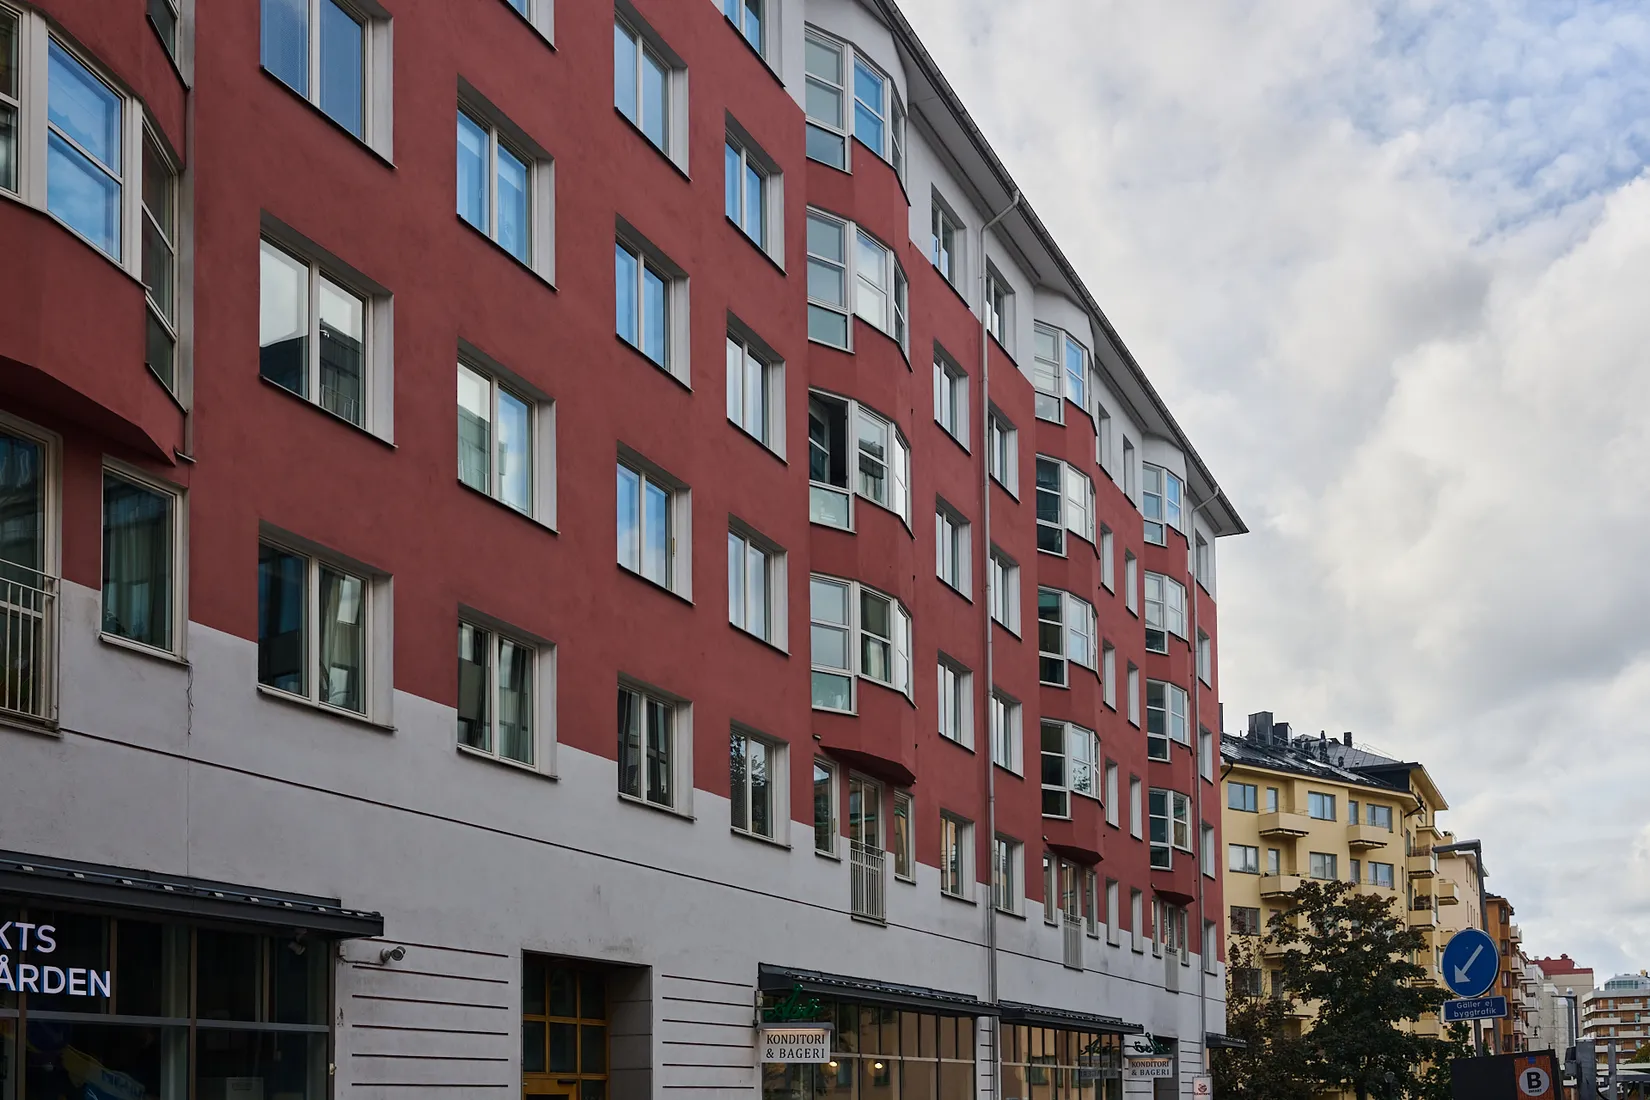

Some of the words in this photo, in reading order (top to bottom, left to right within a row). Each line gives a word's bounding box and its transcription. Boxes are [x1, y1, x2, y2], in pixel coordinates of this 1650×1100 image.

[0, 921, 57, 954] KTS
[0, 954, 111, 998] ÅRDEN
[1456, 1001, 1481, 1009] Gäller
[1485, 999, 1493, 1008] ej
[1453, 1008, 1497, 1018] byggtrafik
[766, 1034, 825, 1045] KONDITORI
[766, 1048, 774, 1059] &
[779, 1048, 825, 1059] BAGERI
[1527, 1072, 1542, 1089] B
